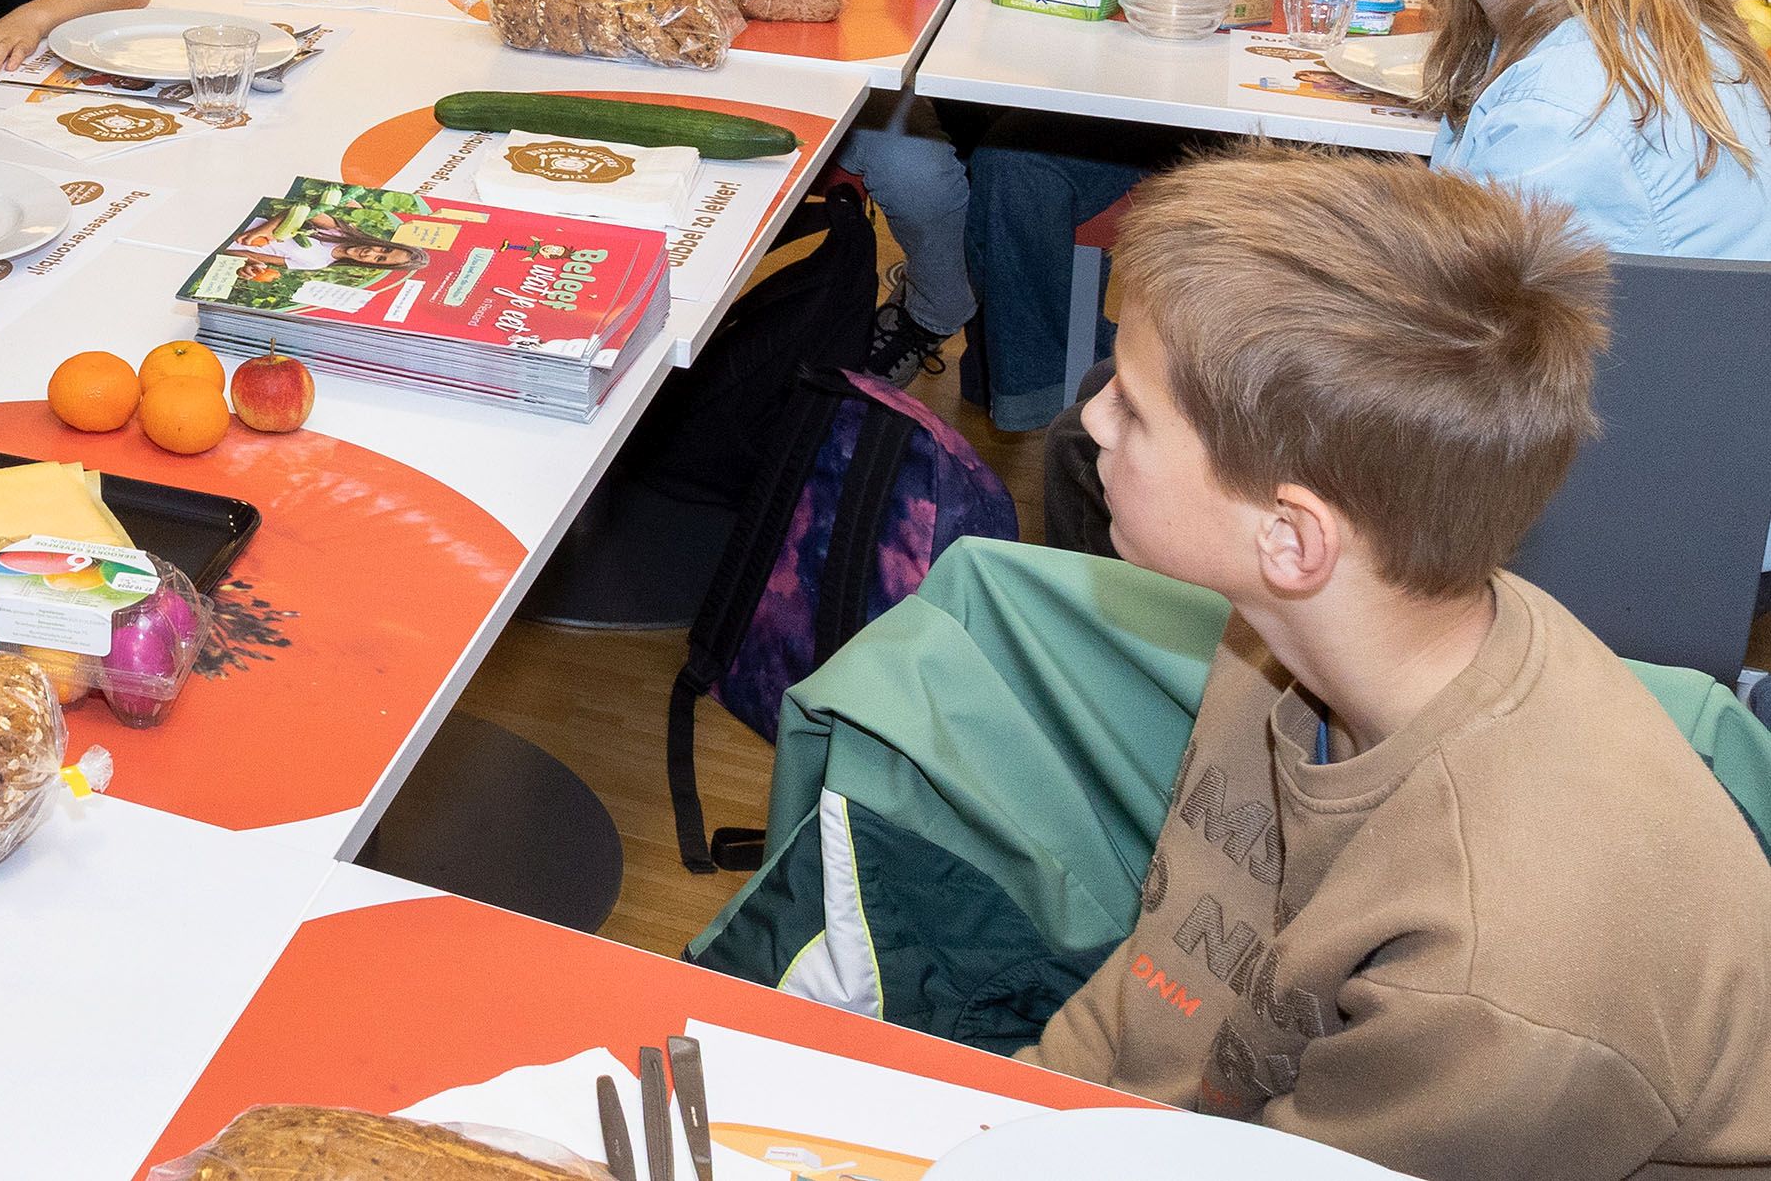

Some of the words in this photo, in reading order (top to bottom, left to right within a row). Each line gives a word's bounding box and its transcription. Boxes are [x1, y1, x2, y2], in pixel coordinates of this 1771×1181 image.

[433, 152, 465, 185] gezond
[702, 180, 743, 214] lekker!
[27, 190, 151, 276] Burgemeestersontbijt
[519, 264, 556, 297] wat
[539, 248, 608, 311] Beleef
[492, 286, 536, 309] je
[495, 309, 532, 336] eet
[67, 554, 92, 572] 6
[85, 546, 137, 560] GEKOOKTE
[1130, 952, 1202, 1018] DNM
